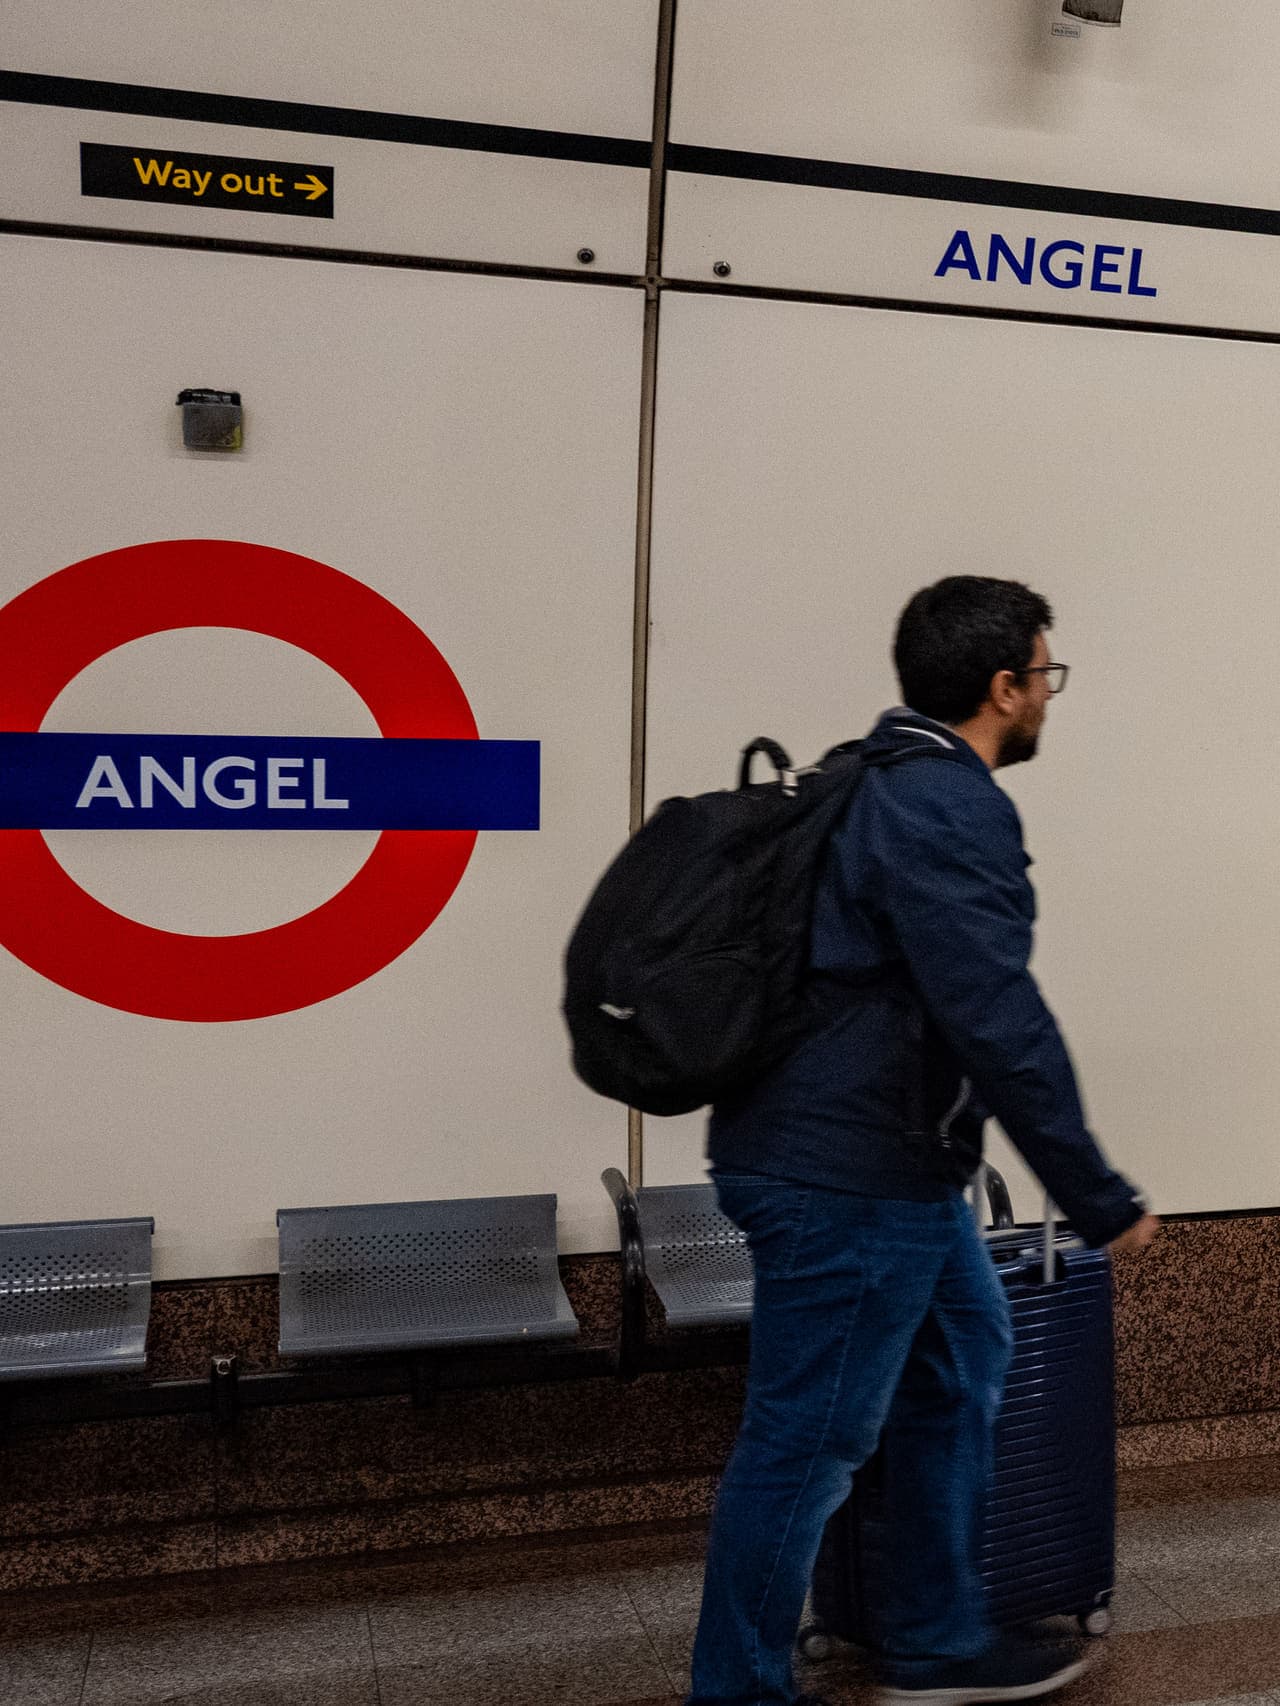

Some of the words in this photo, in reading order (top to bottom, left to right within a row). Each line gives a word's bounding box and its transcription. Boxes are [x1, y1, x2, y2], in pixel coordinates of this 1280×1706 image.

[133, 157, 212, 196] Way
[220, 173, 284, 197] out
[934, 229, 1157, 297] ANGEL
[75, 755, 350, 809] ANGEL
